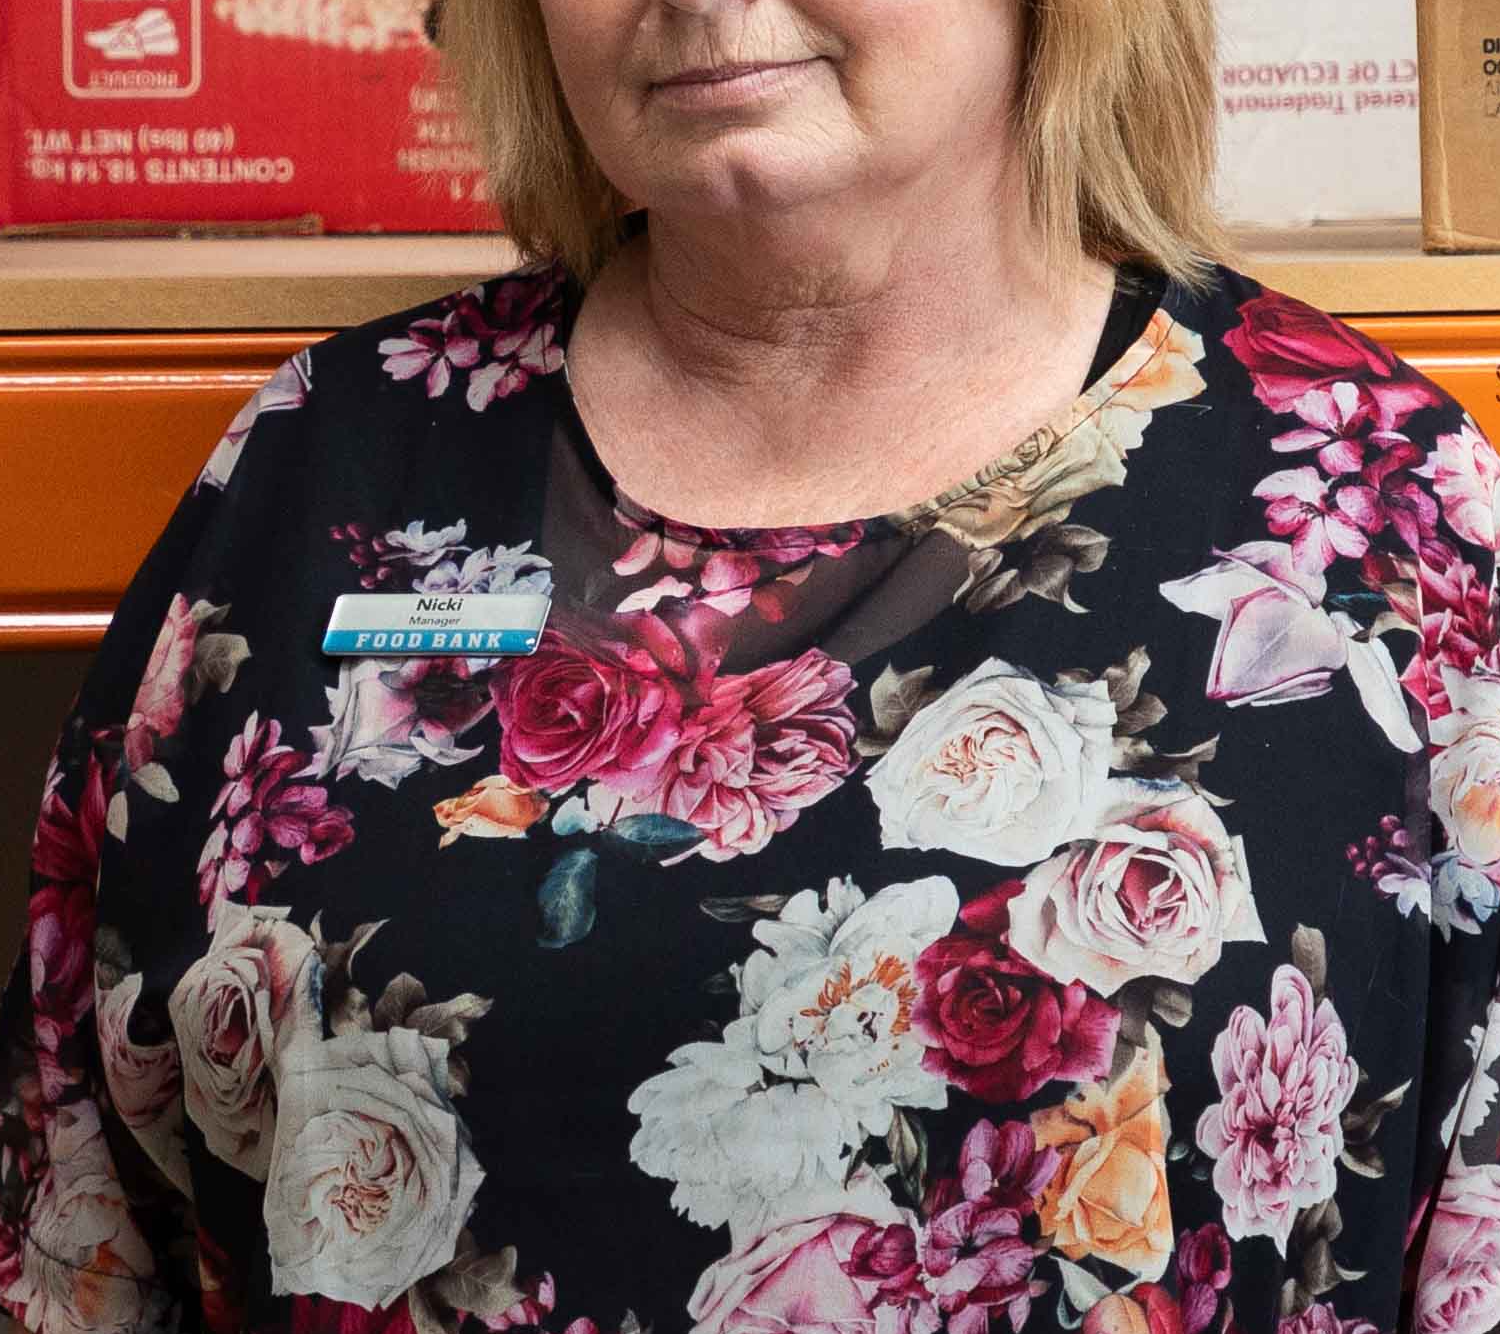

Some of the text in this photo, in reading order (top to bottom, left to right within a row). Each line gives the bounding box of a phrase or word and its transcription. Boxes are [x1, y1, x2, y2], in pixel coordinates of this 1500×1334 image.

[1222, 63, 1338, 87] ECUADOR
[1224, 92, 1345, 115] Trademark
[79, 128, 132, 154] NET
[145, 156, 295, 183] CONTENTS
[416, 598, 464, 612] Nicki
[408, 616, 461, 628] Manager
[355, 632, 501, 648] FOOD BANK
